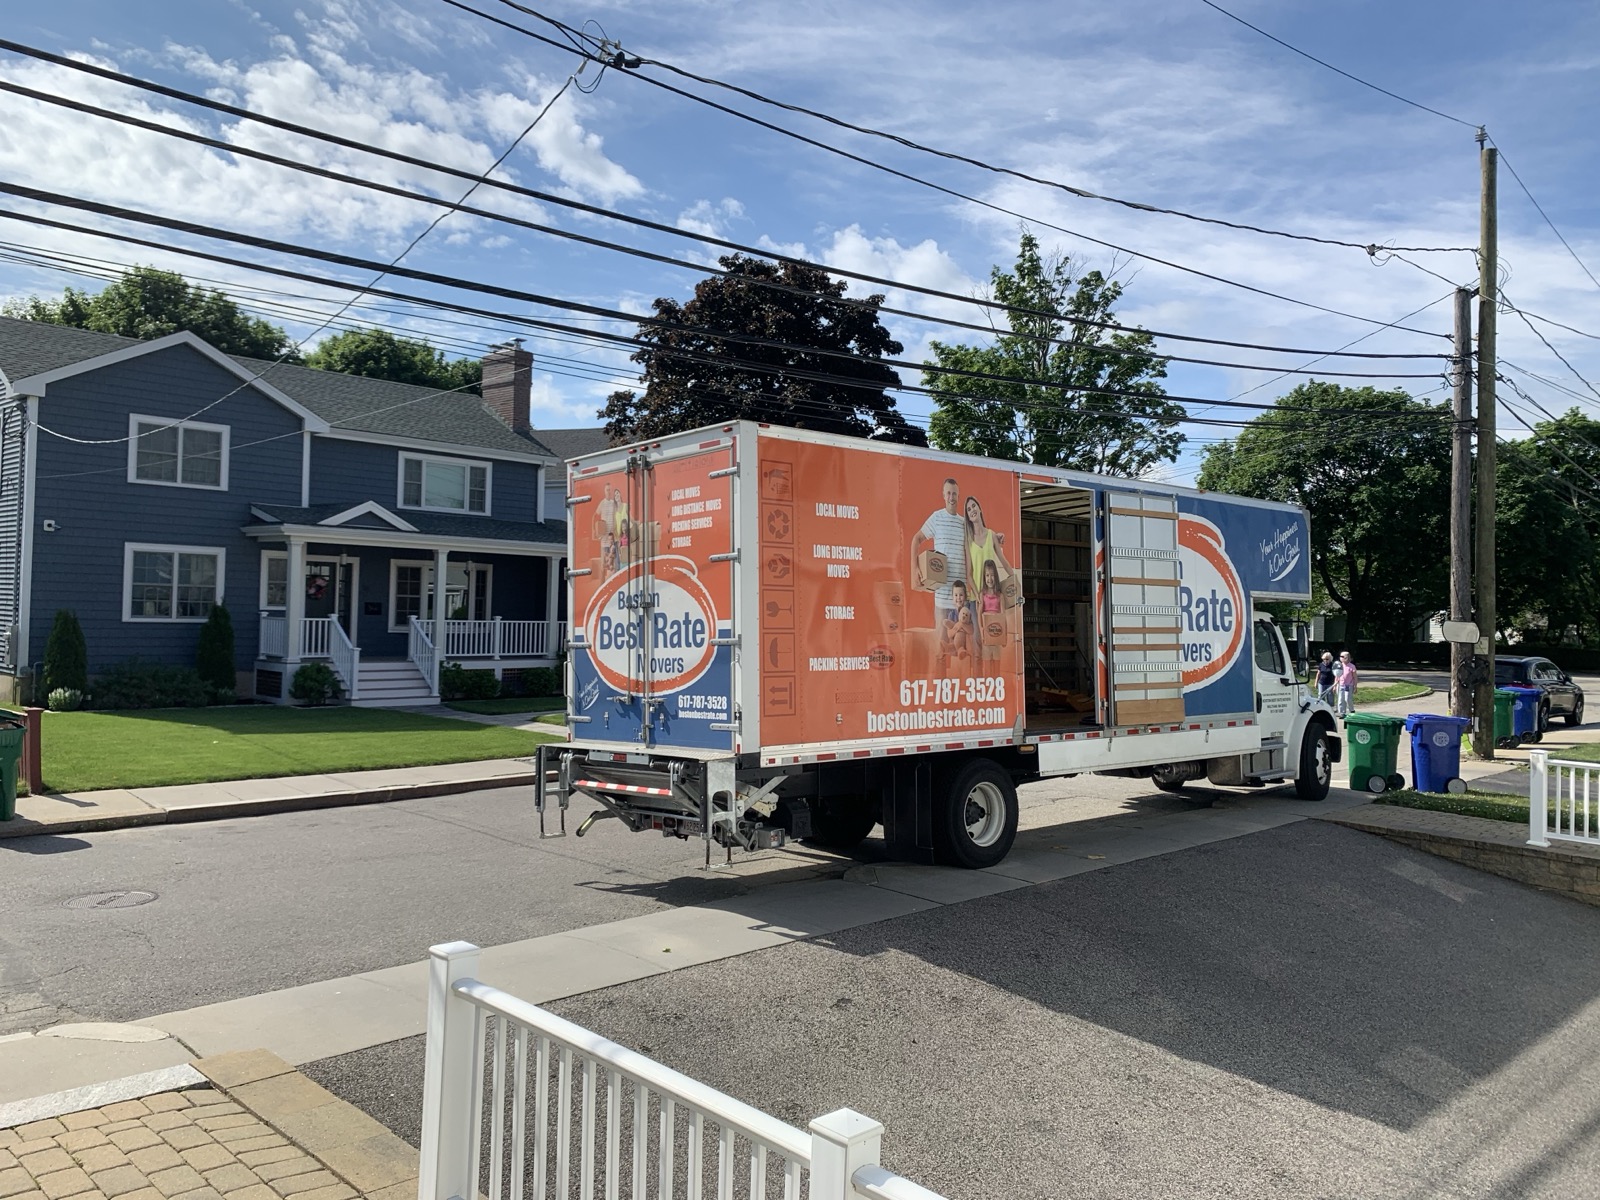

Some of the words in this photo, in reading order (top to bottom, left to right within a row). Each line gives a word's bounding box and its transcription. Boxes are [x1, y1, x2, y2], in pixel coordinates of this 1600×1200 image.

[671, 488, 685, 501] LOCAL
[685, 485, 701, 499] MOVES
[671, 504, 683, 517] LONG
[683, 501, 705, 515] DISTANCE
[705, 498, 722, 512] MOVES
[815, 502, 836, 518] LOCAL
[836, 505, 859, 520] MOVES
[671, 519, 691, 533] PACKING
[691, 516, 713, 530] SERVICES
[671, 535, 692, 549] STORAGE
[1259, 538, 1274, 562] Your
[1274, 521, 1299, 549] Happiness
[813, 543, 831, 559] LONG
[831, 545, 863, 560] DISTANCE
[827, 563, 850, 579] MOVES
[825, 605, 855, 620] STORAGE
[1180, 586, 1233, 632] Rate
[599, 614, 645, 650] Best
[653, 611, 705, 649] Rate
[1182, 642, 1212, 663] vers
[809, 656, 838, 672] PACKING
[839, 656, 870, 671] SERVICES
[900, 676, 1006, 707] 617-787-3528
[678, 694, 728, 710] 617-787-3528
[678, 709, 728, 721] bostonbestrate.com
[867, 706, 1006, 733] bostonbestrate.com
